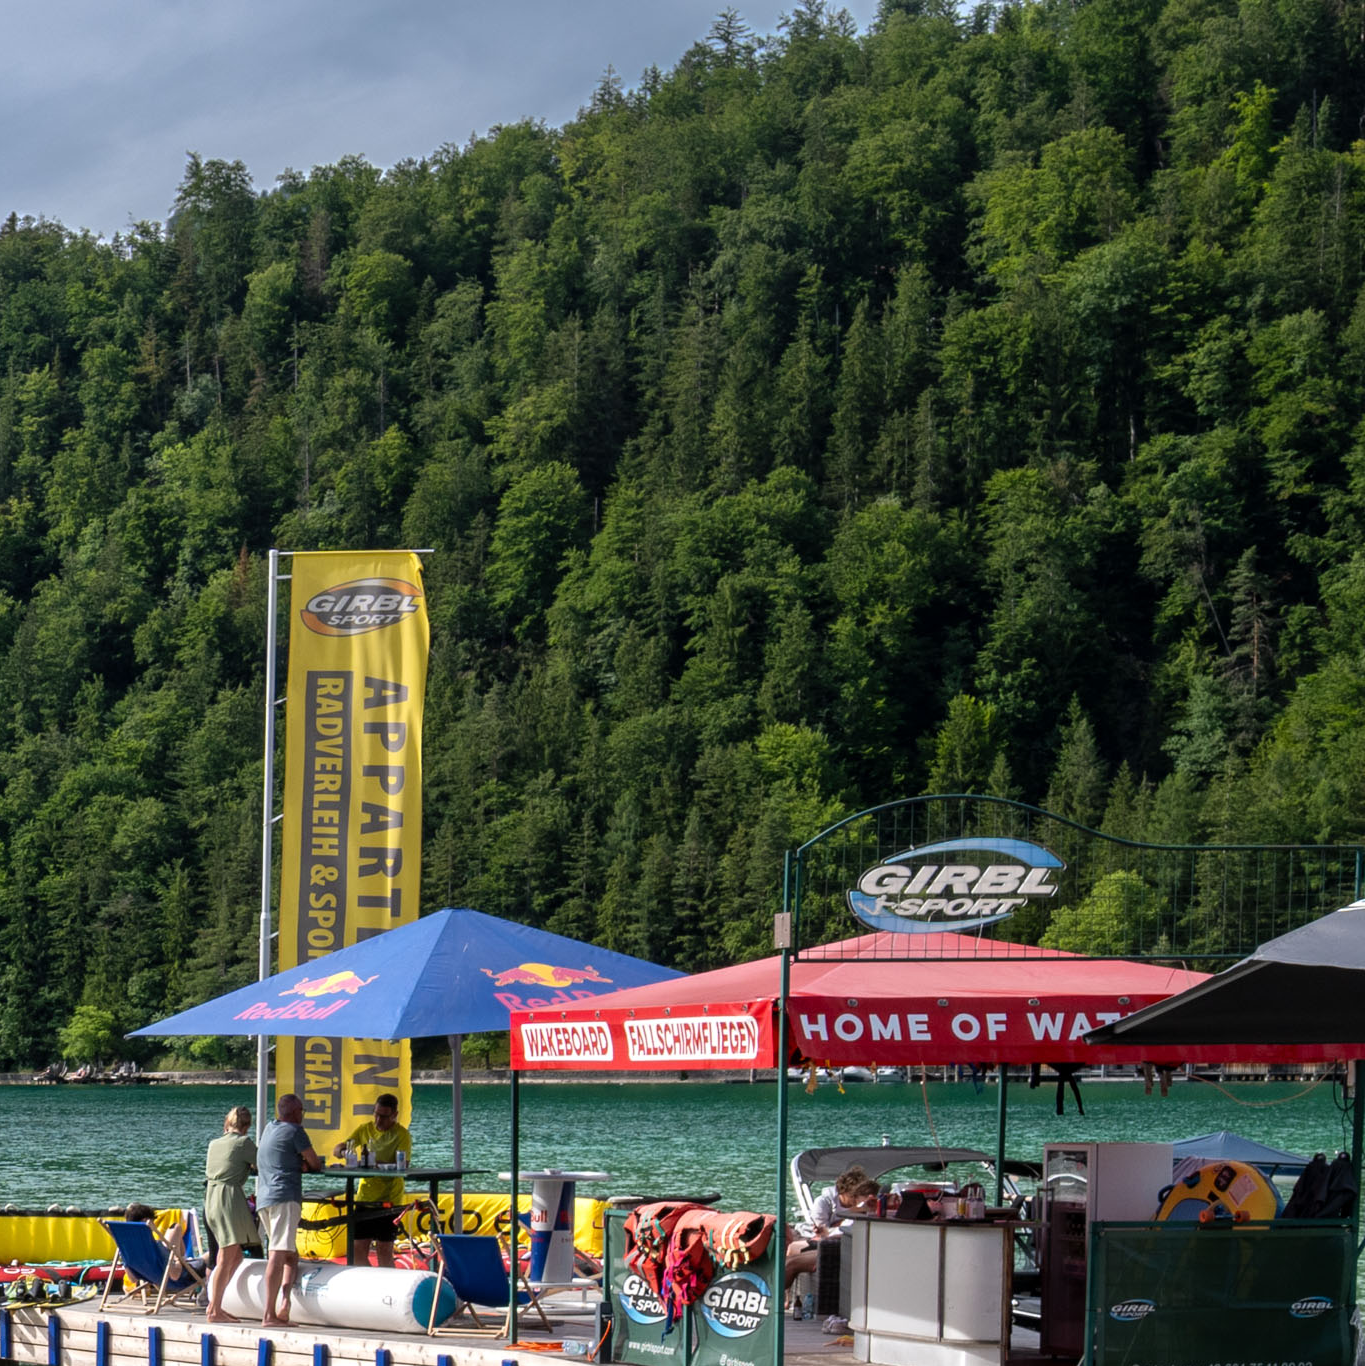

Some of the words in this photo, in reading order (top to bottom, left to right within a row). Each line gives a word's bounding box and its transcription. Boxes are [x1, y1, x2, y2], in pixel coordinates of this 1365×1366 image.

[307, 594, 419, 613] GIRBL
[328, 614, 400, 625] SPORT
[311, 677, 345, 857] RADVERLEIH
[309, 863, 338, 886] &
[860, 864, 1057, 895] GIRBL
[894, 898, 1026, 916] SPORT
[629, 1020, 756, 1056] FALLSCHIRMFLIEGEN
[799, 1013, 932, 1041] HOME
[951, 1013, 1007, 1041] OF
[525, 1025, 609, 1057] WAKEBOARD
[703, 1286, 770, 1315] GIRBL
[1111, 1304, 1156, 1312] GIRBL
[1291, 1301, 1333, 1310] GIRBL
[720, 1313, 761, 1329] SPORT
